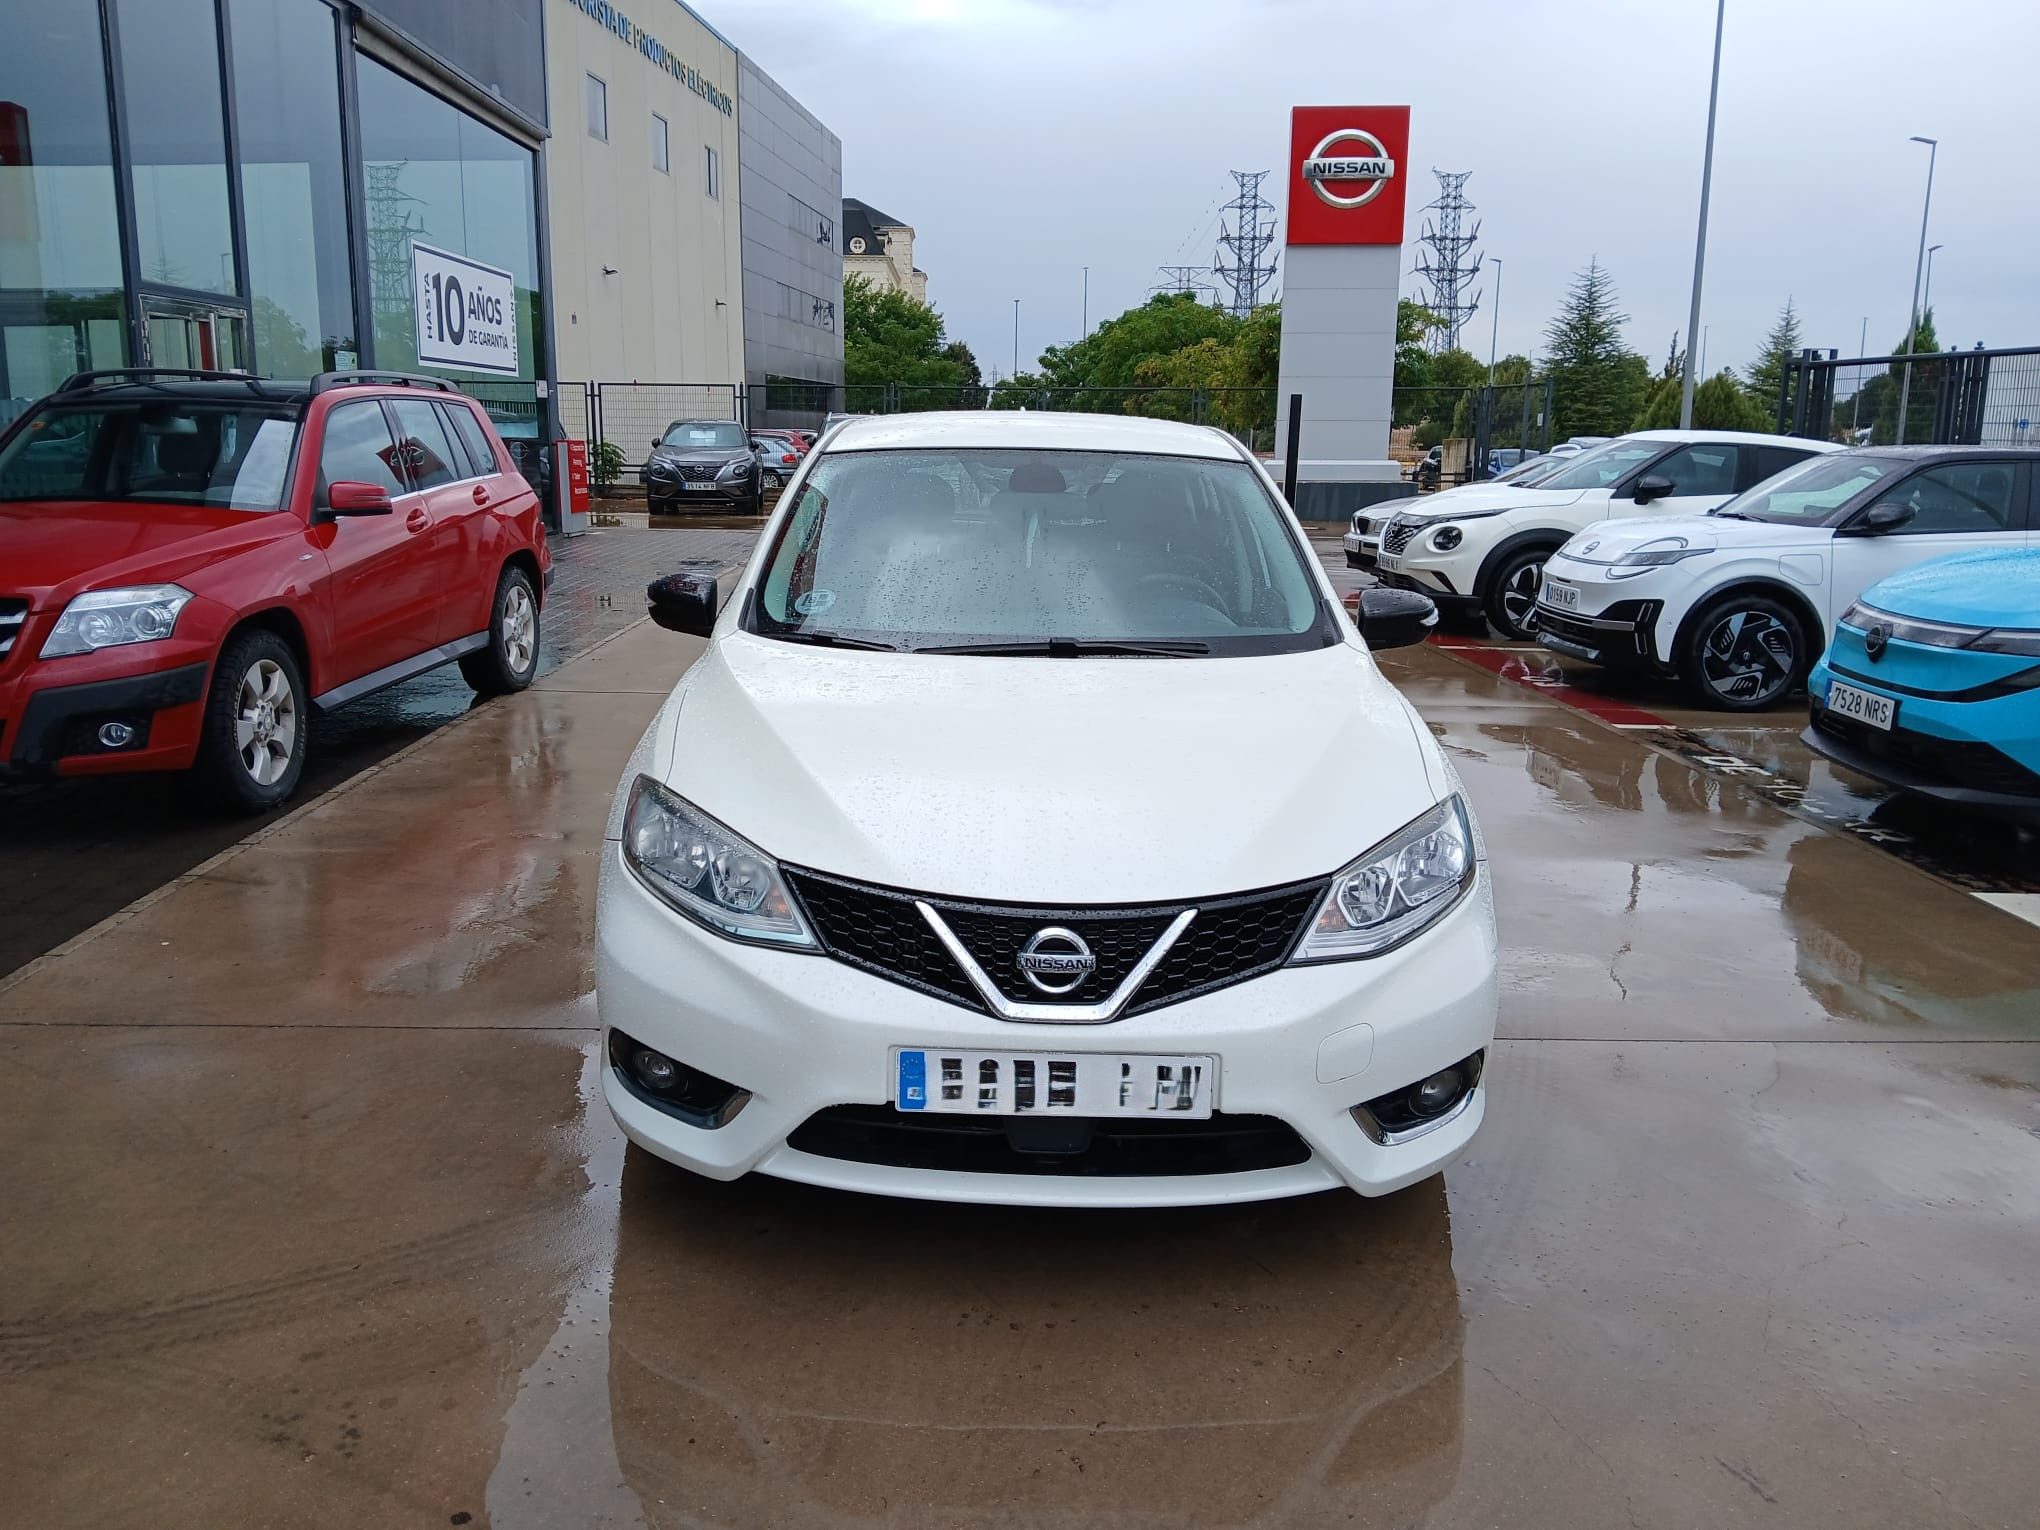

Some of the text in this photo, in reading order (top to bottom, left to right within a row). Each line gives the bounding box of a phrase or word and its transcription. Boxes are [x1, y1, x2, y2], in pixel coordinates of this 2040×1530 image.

[618, 12, 632, 46] DE
[633, 24, 686, 85] PRODUCTOS
[687, 65, 732, 118] ELÉCTRICOS
[1312, 162, 1386, 174] NISSAN
[423, 272, 433, 339] HASTA
[432, 272, 503, 346] 10 AÑOS
[469, 329, 509, 350] DE GARANTÍA
[1833, 687, 1888, 723] 7528 NRS
[1025, 957, 1088, 969] NISSAN
